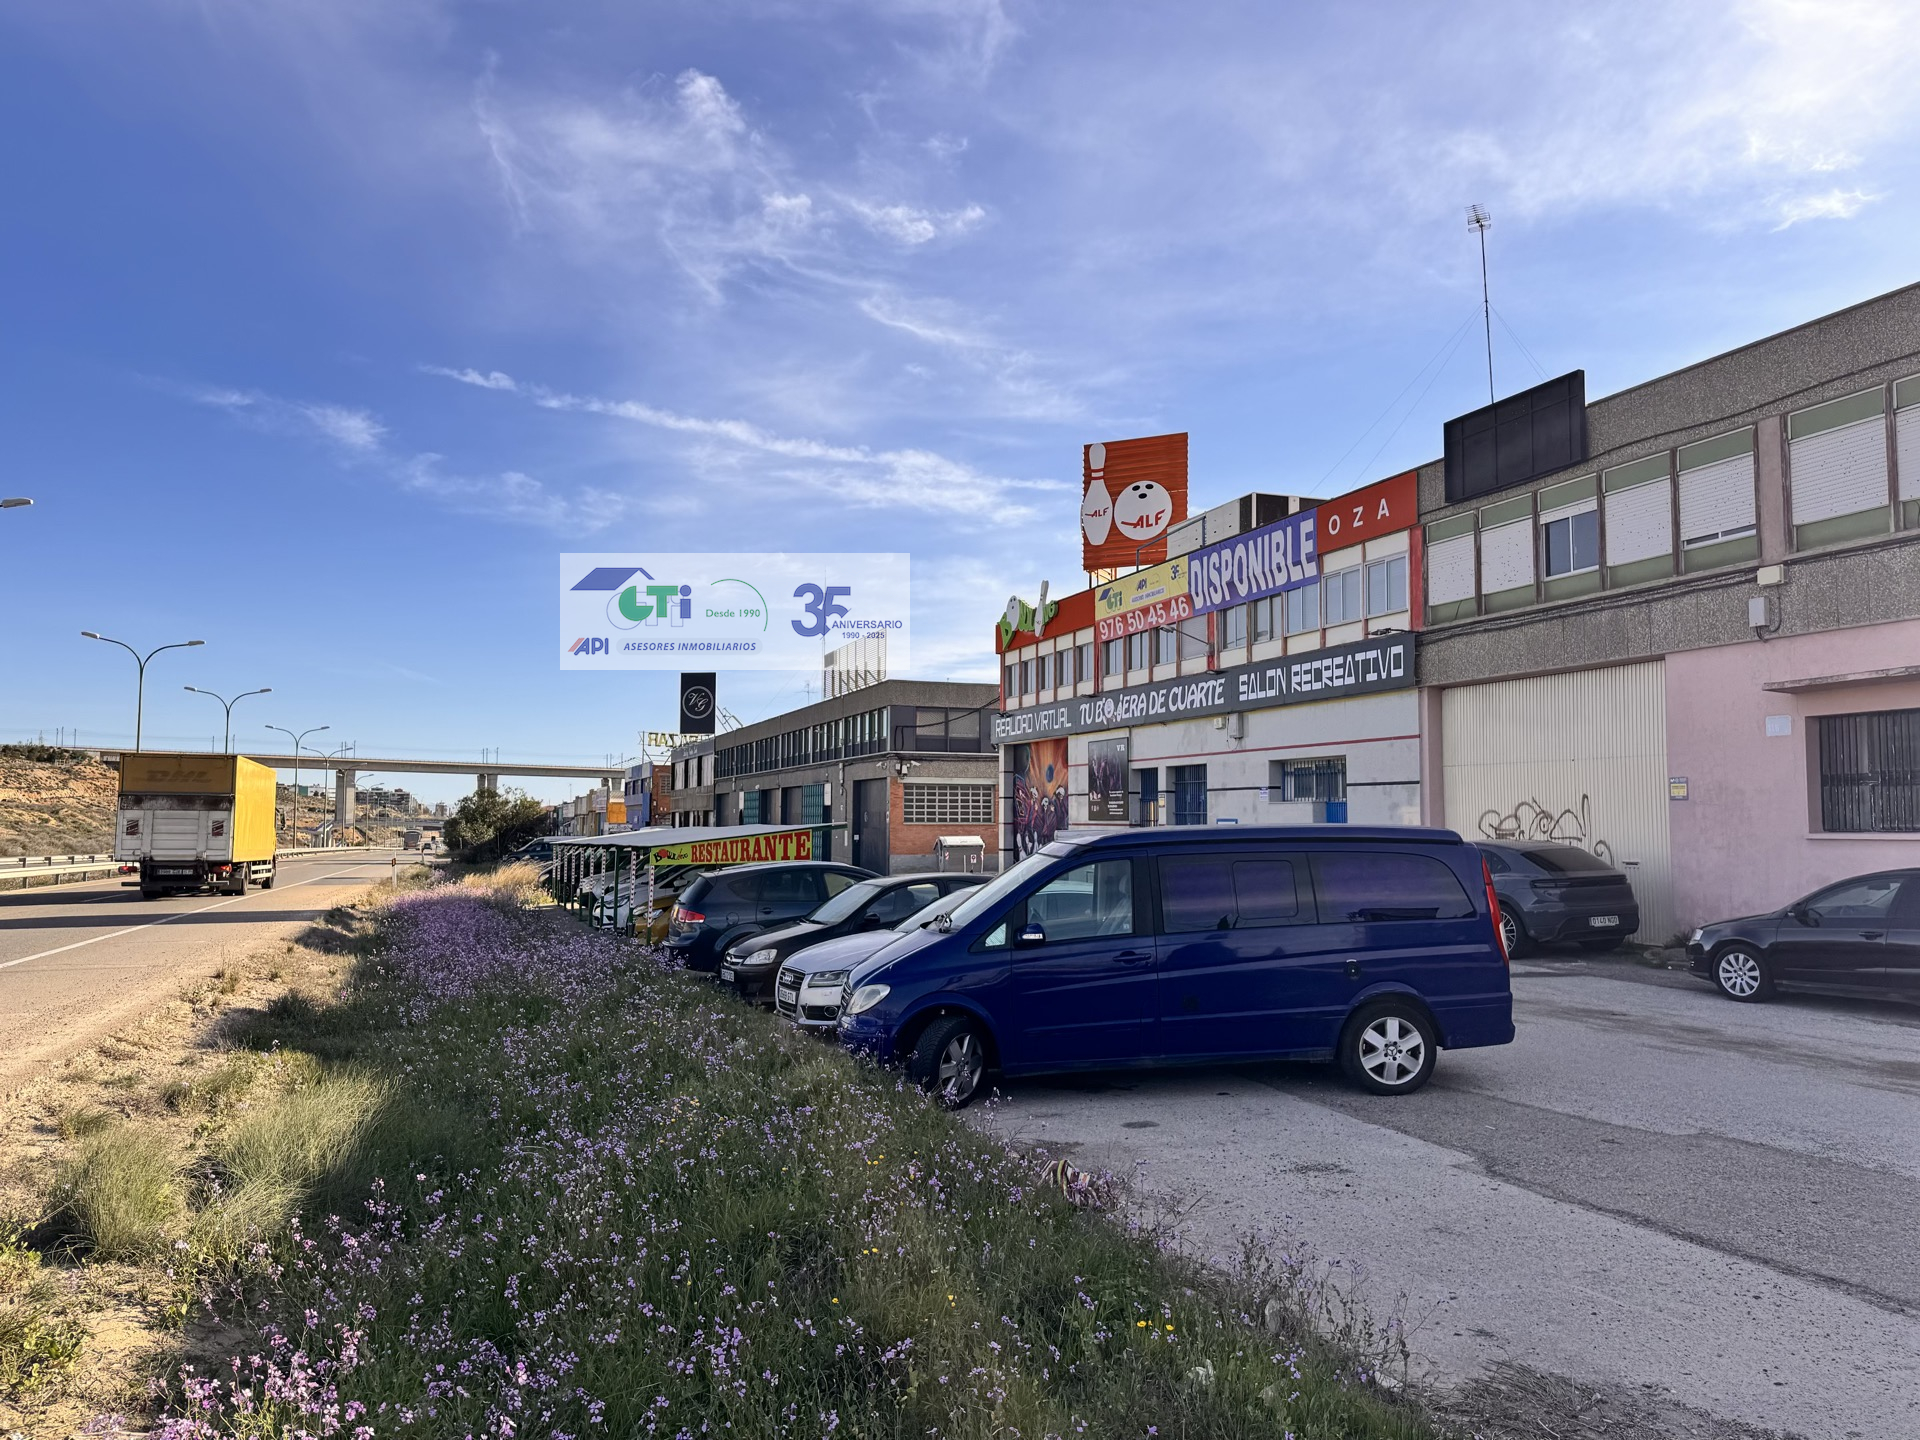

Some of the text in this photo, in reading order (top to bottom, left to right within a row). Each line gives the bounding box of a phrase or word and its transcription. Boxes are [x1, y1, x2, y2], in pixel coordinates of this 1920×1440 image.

[1085, 507, 1109, 518] ALF
[1121, 509, 1165, 528] ALF
[1190, 518, 1318, 610] DISPONIBLE
[1100, 597, 1189, 640] 976 50 45 46
[1239, 645, 1404, 701] SALON RECREATIVO
[1079, 702, 1094, 725] TU
[1149, 689, 1167, 714] DE
[1169, 678, 1226, 711] CUARTE
[995, 707, 1072, 738] REALIDAD VIRTUAL
[1116, 744, 1125, 752] VR
[146, 769, 212, 784] DHL
[691, 831, 811, 863] RESTAURANTE
